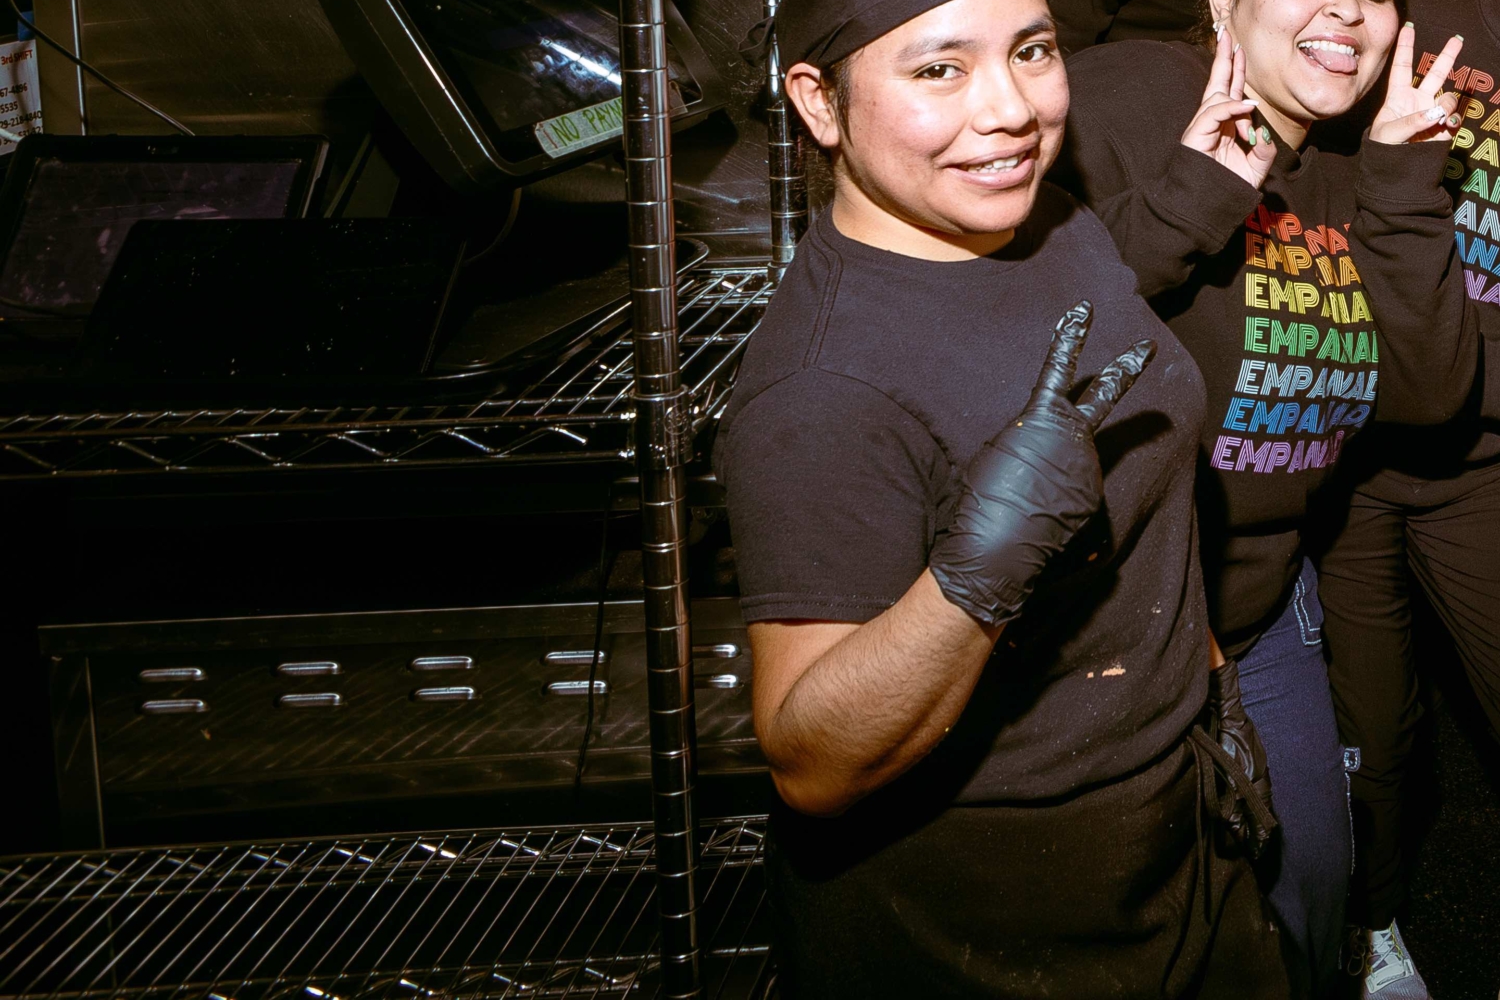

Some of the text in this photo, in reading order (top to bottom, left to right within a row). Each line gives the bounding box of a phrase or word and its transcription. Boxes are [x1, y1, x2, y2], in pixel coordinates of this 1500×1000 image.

[1, 49, 33, 66] 3rd SHIFT
[551, 99, 623, 147] NO PAYM
